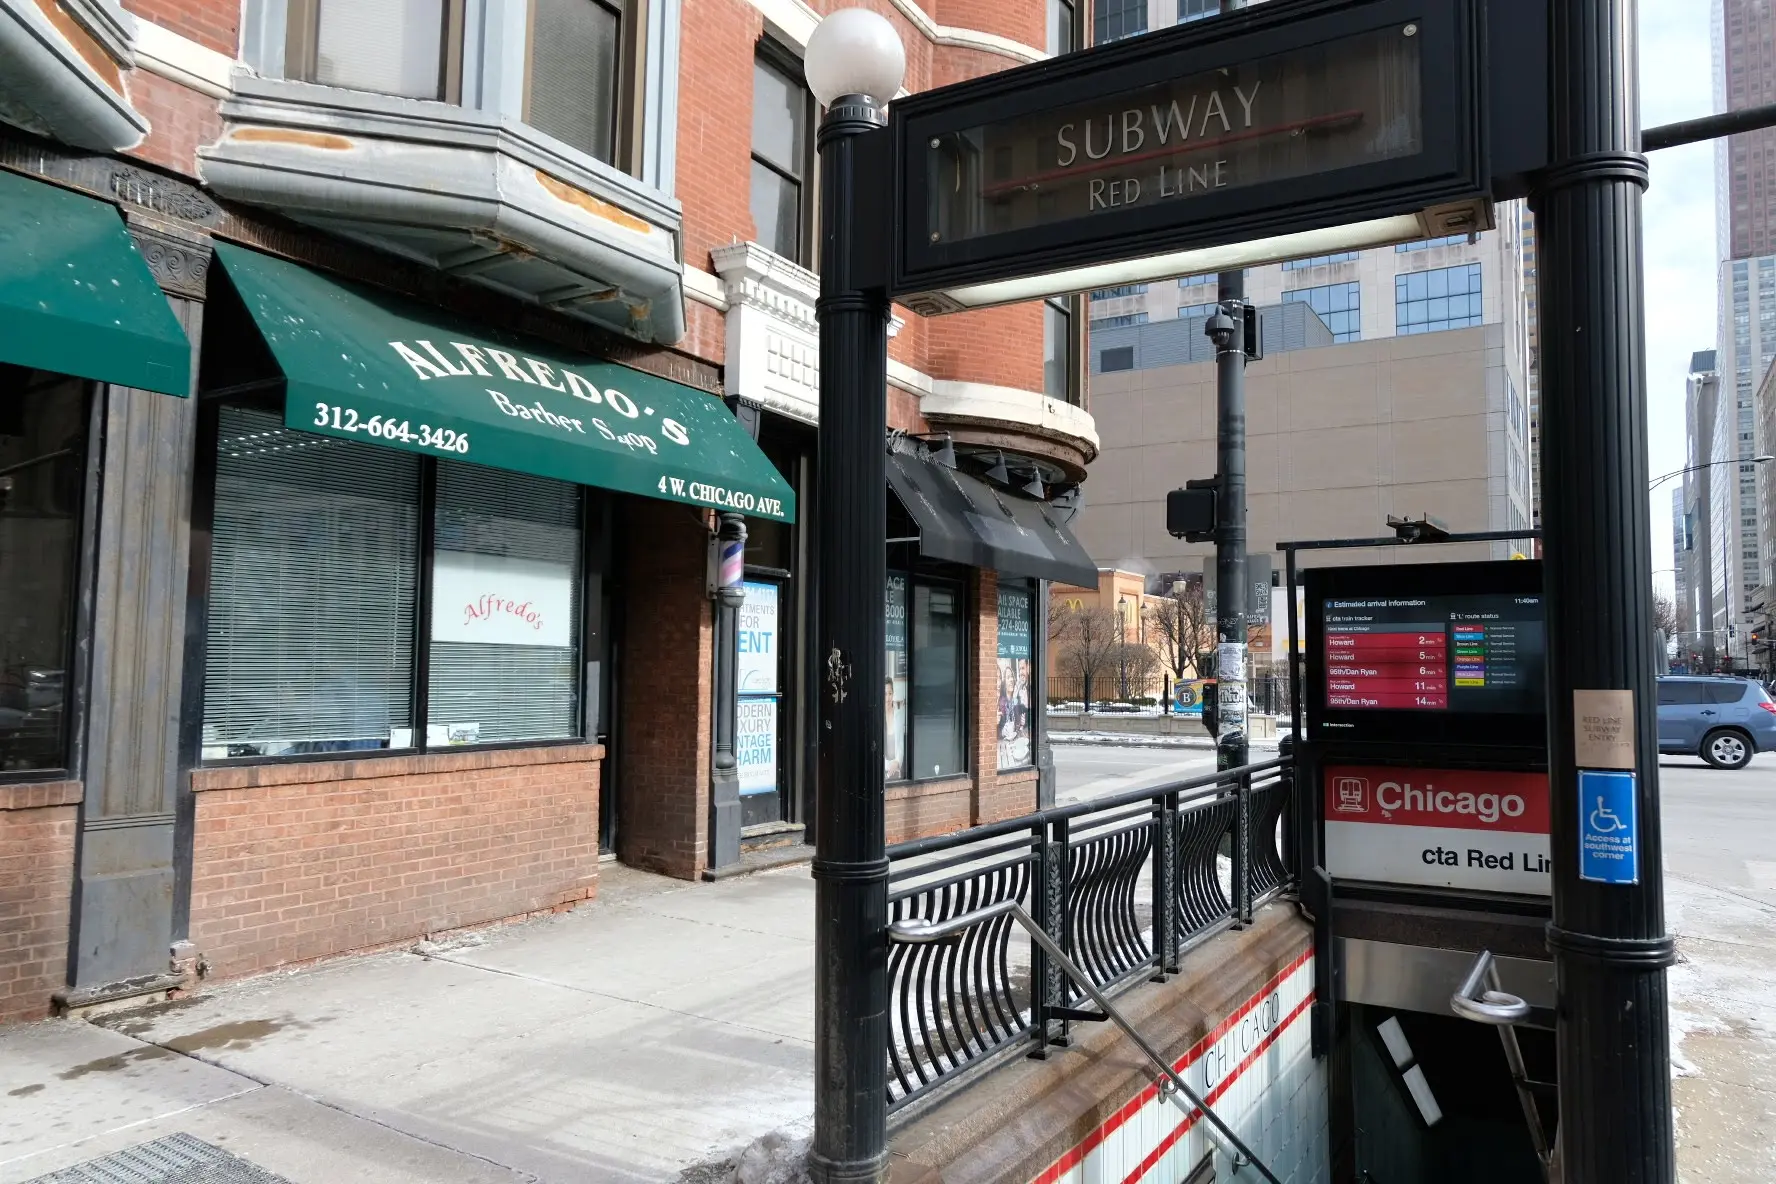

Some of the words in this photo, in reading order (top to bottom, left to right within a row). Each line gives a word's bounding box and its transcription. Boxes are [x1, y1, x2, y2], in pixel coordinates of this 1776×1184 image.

[1057, 80, 1261, 167] SUBWAY
[1090, 178, 1141, 211] RED
[1160, 160, 1227, 198] LINE
[387, 339, 691, 446] ALFREDO'S
[485, 388, 587, 434] Barber
[313, 402, 470, 454] 312-664-3426
[658, 476, 668, 494] 4
[669, 477, 687, 498] W.
[688, 481, 755, 511] CHICAGO
[756, 497, 785, 517] AVE.
[997, 593, 1008, 606] AIL
[1334, 600, 1366, 608] Estimated
[1388, 599, 1426, 607] information
[740, 615, 762, 629] FOR
[1329, 638, 1354, 646] Howard
[1418, 636, 1425, 645] 2
[1329, 653, 1355, 661] Howard
[1419, 651, 1426, 660] 5
[1360, 668, 1378, 677] Ryan
[1419, 666, 1426, 675] 6
[1330, 682, 1355, 690] Howard
[1414, 682, 1425, 690] 11
[1360, 697, 1378, 706] Ryan
[1415, 697, 1427, 705] 14
[738, 718, 771, 733] XURY
[1376, 781, 1526, 823] Chicago
[1584, 833, 1621, 844] Access
[1622, 834, 1632, 844] at
[1583, 842, 1633, 852] southwest
[1421, 846, 1459, 867] cta
[1467, 849, 1515, 871] Red
[1592, 851, 1625, 860] corner
[1205, 992, 1280, 1089] CHICAGO
